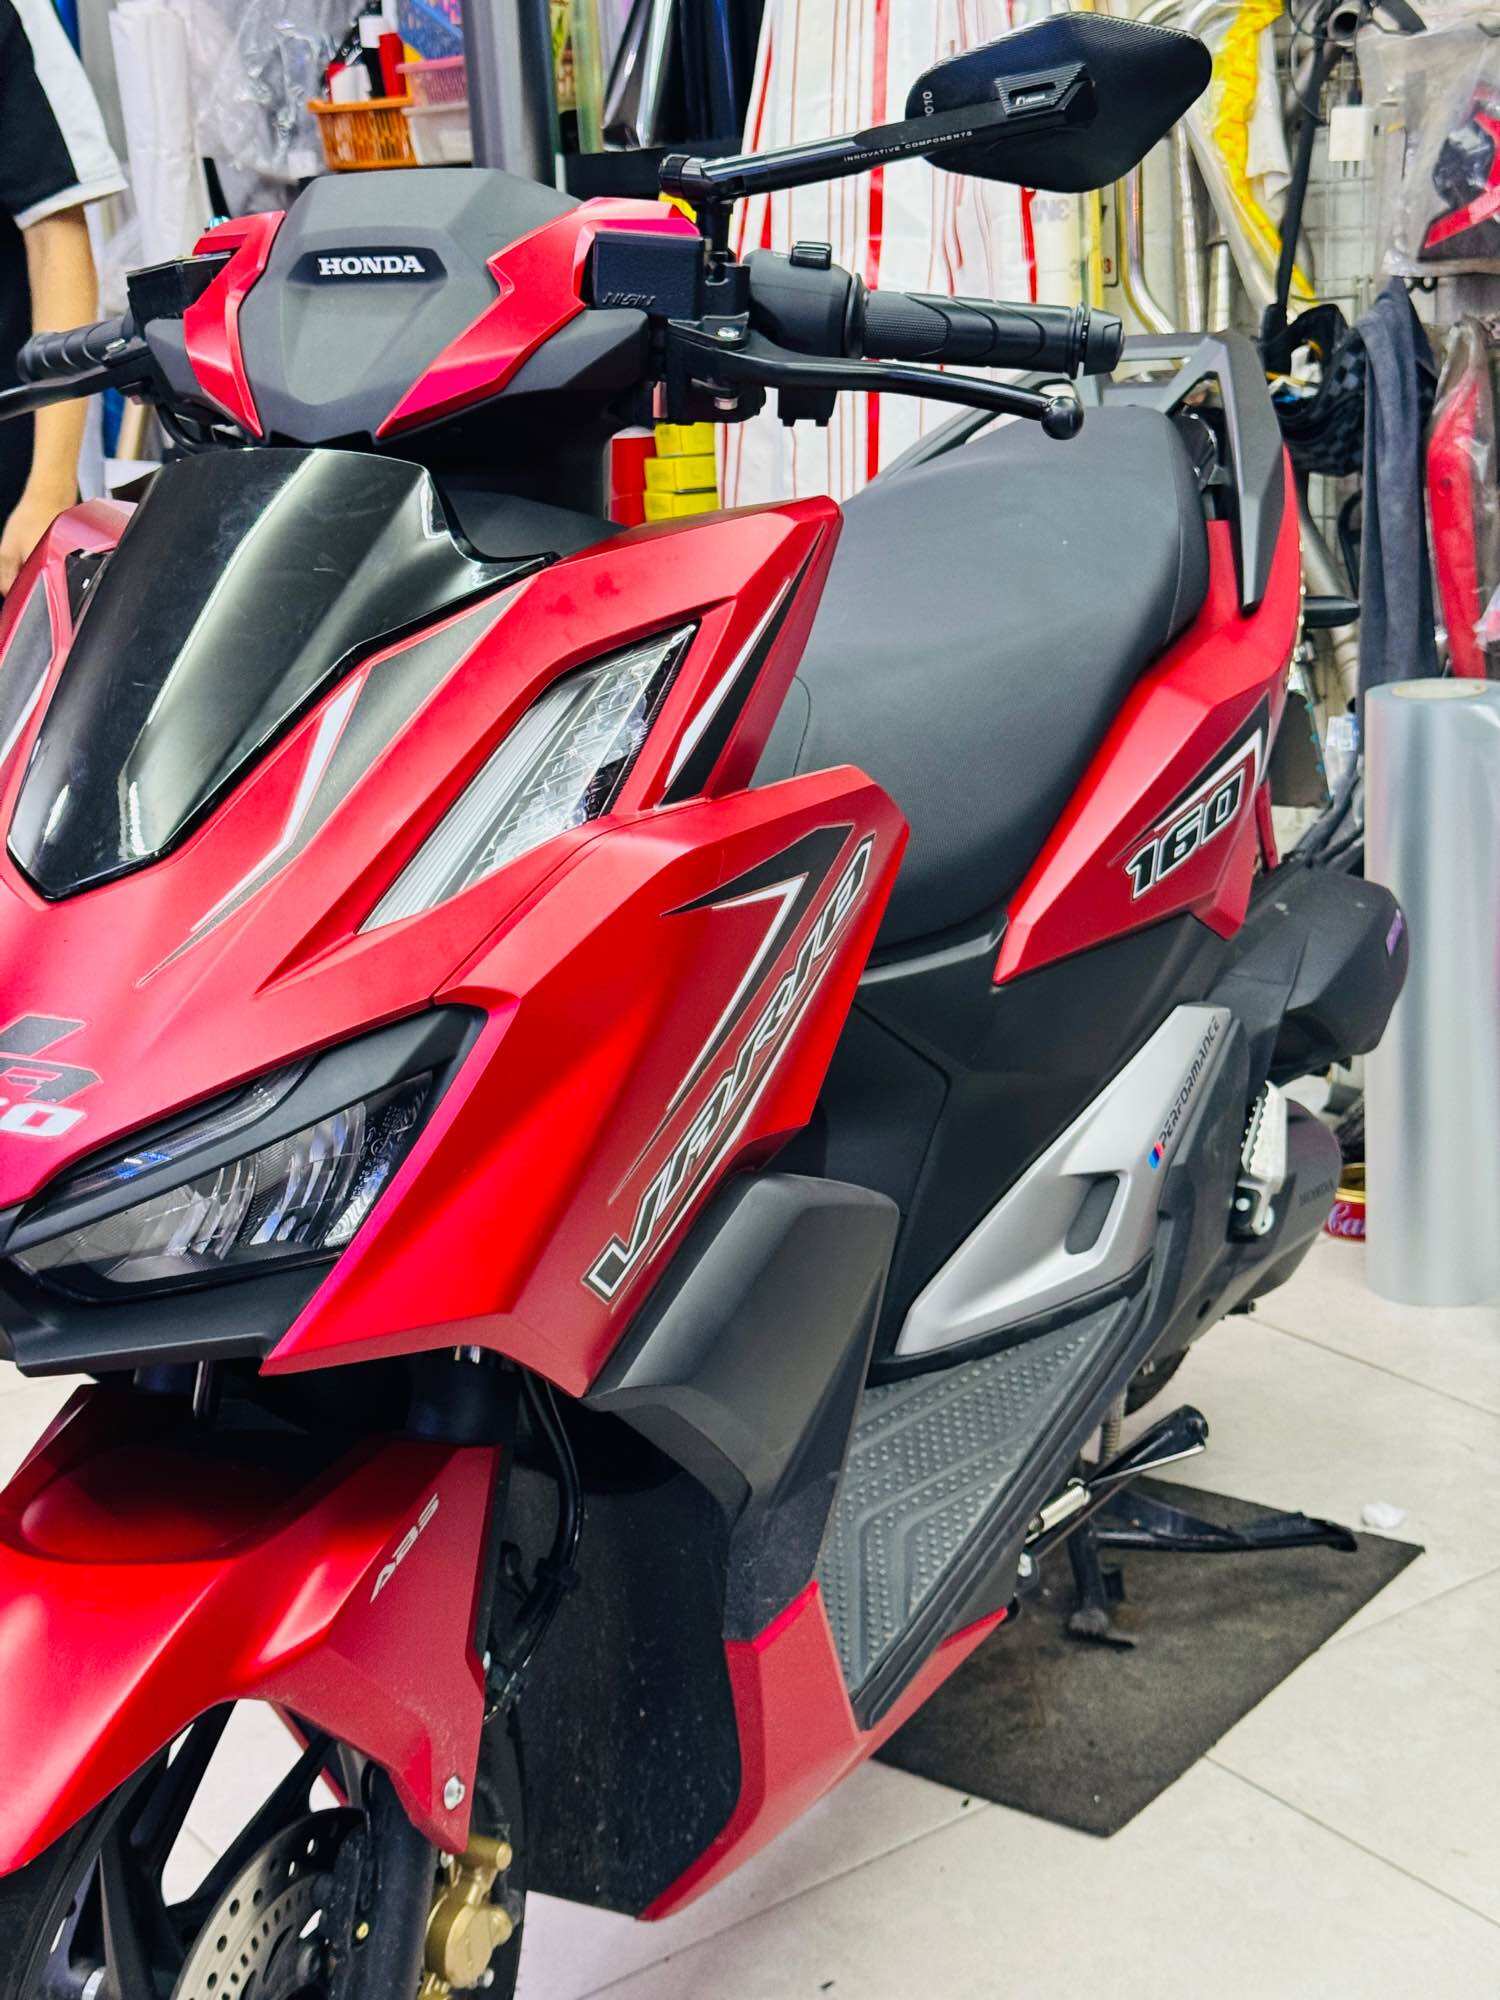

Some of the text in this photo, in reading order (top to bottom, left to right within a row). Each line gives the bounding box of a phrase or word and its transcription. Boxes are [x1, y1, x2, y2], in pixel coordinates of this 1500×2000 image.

[843, 130, 973, 162] INNOVATIVE COMPONENTS
[317, 255, 425, 275] HONDA
[1124, 767, 1246, 900] 160
[0, 1098, 87, 1138] 0
[582, 833, 876, 1303] VARIO
[1159, 1016, 1220, 1149] PERFORMANCE
[369, 1493, 440, 1604] ABS
